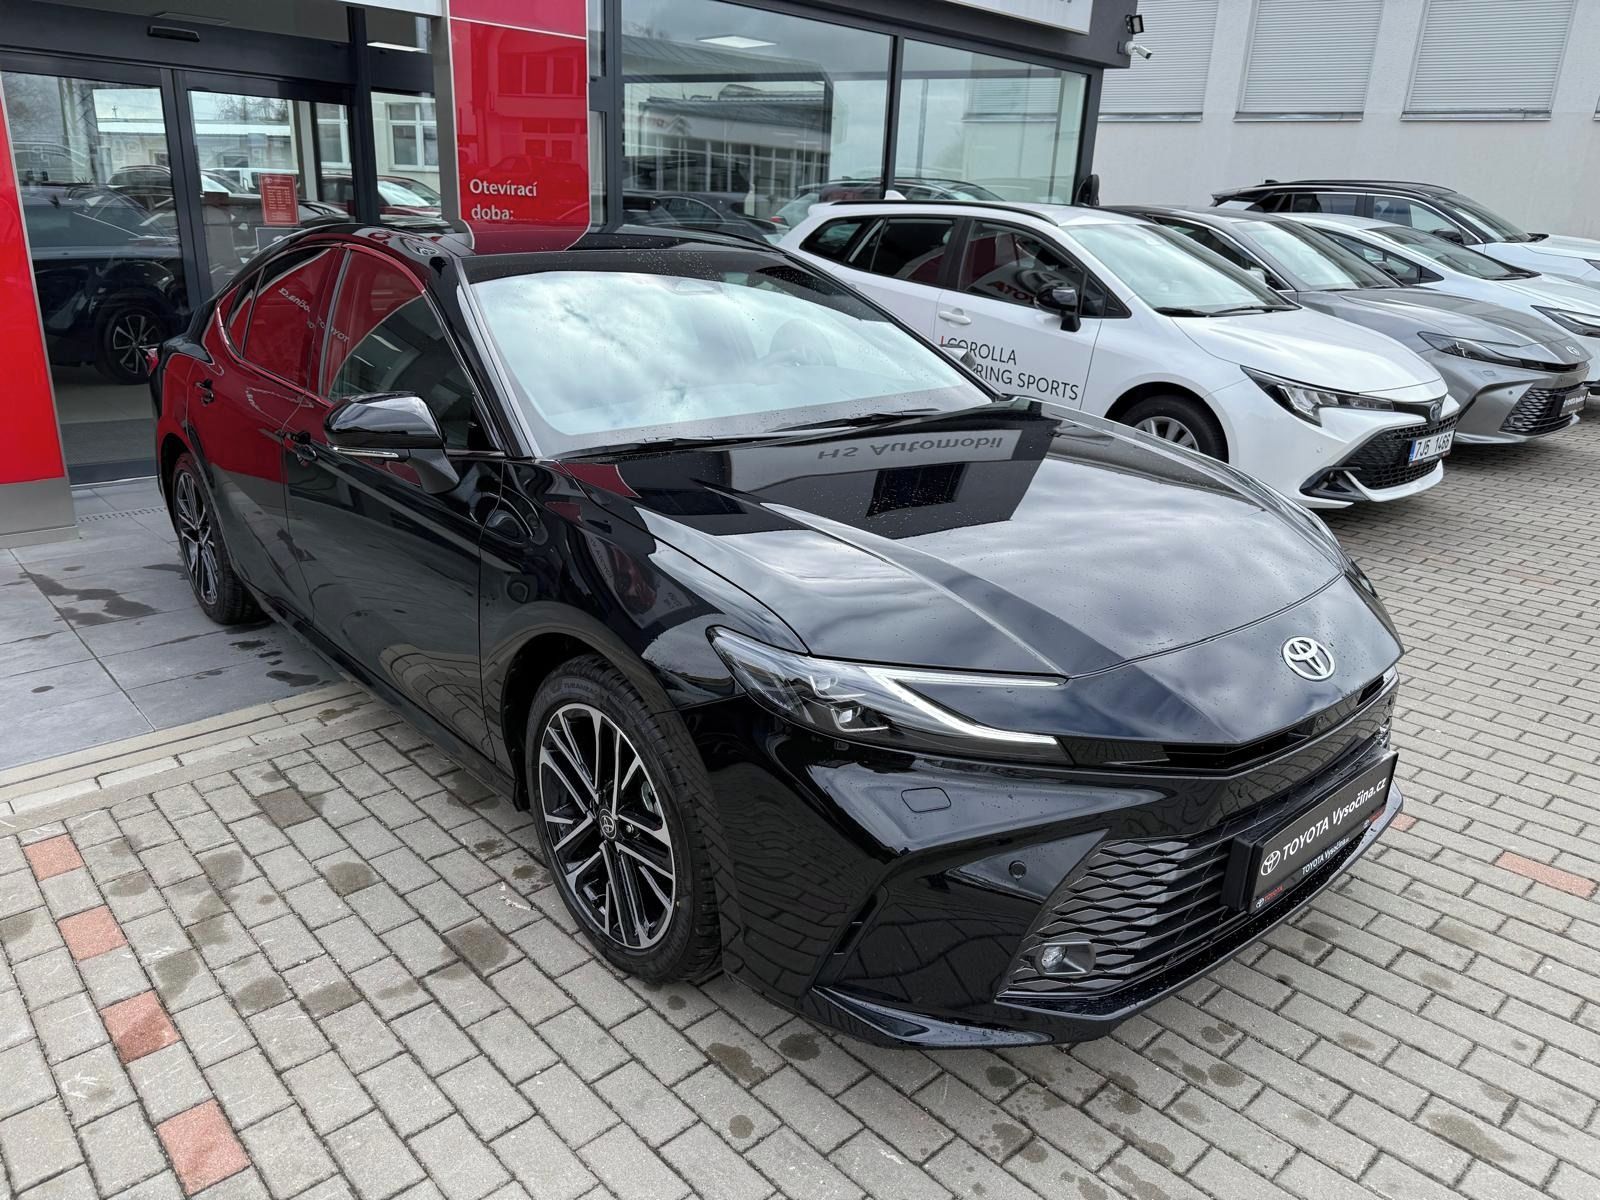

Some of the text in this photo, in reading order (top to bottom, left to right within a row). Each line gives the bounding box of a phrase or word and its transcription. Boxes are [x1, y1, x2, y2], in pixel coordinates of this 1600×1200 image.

[469, 178, 538, 197] Otevírací
[471, 204, 514, 220] doba:
[973, 363, 1079, 401] RING SPORTS
[1282, 777, 1387, 860] TOYOTA Vysočina.cz
[1302, 854, 1325, 875] TOYOTA
